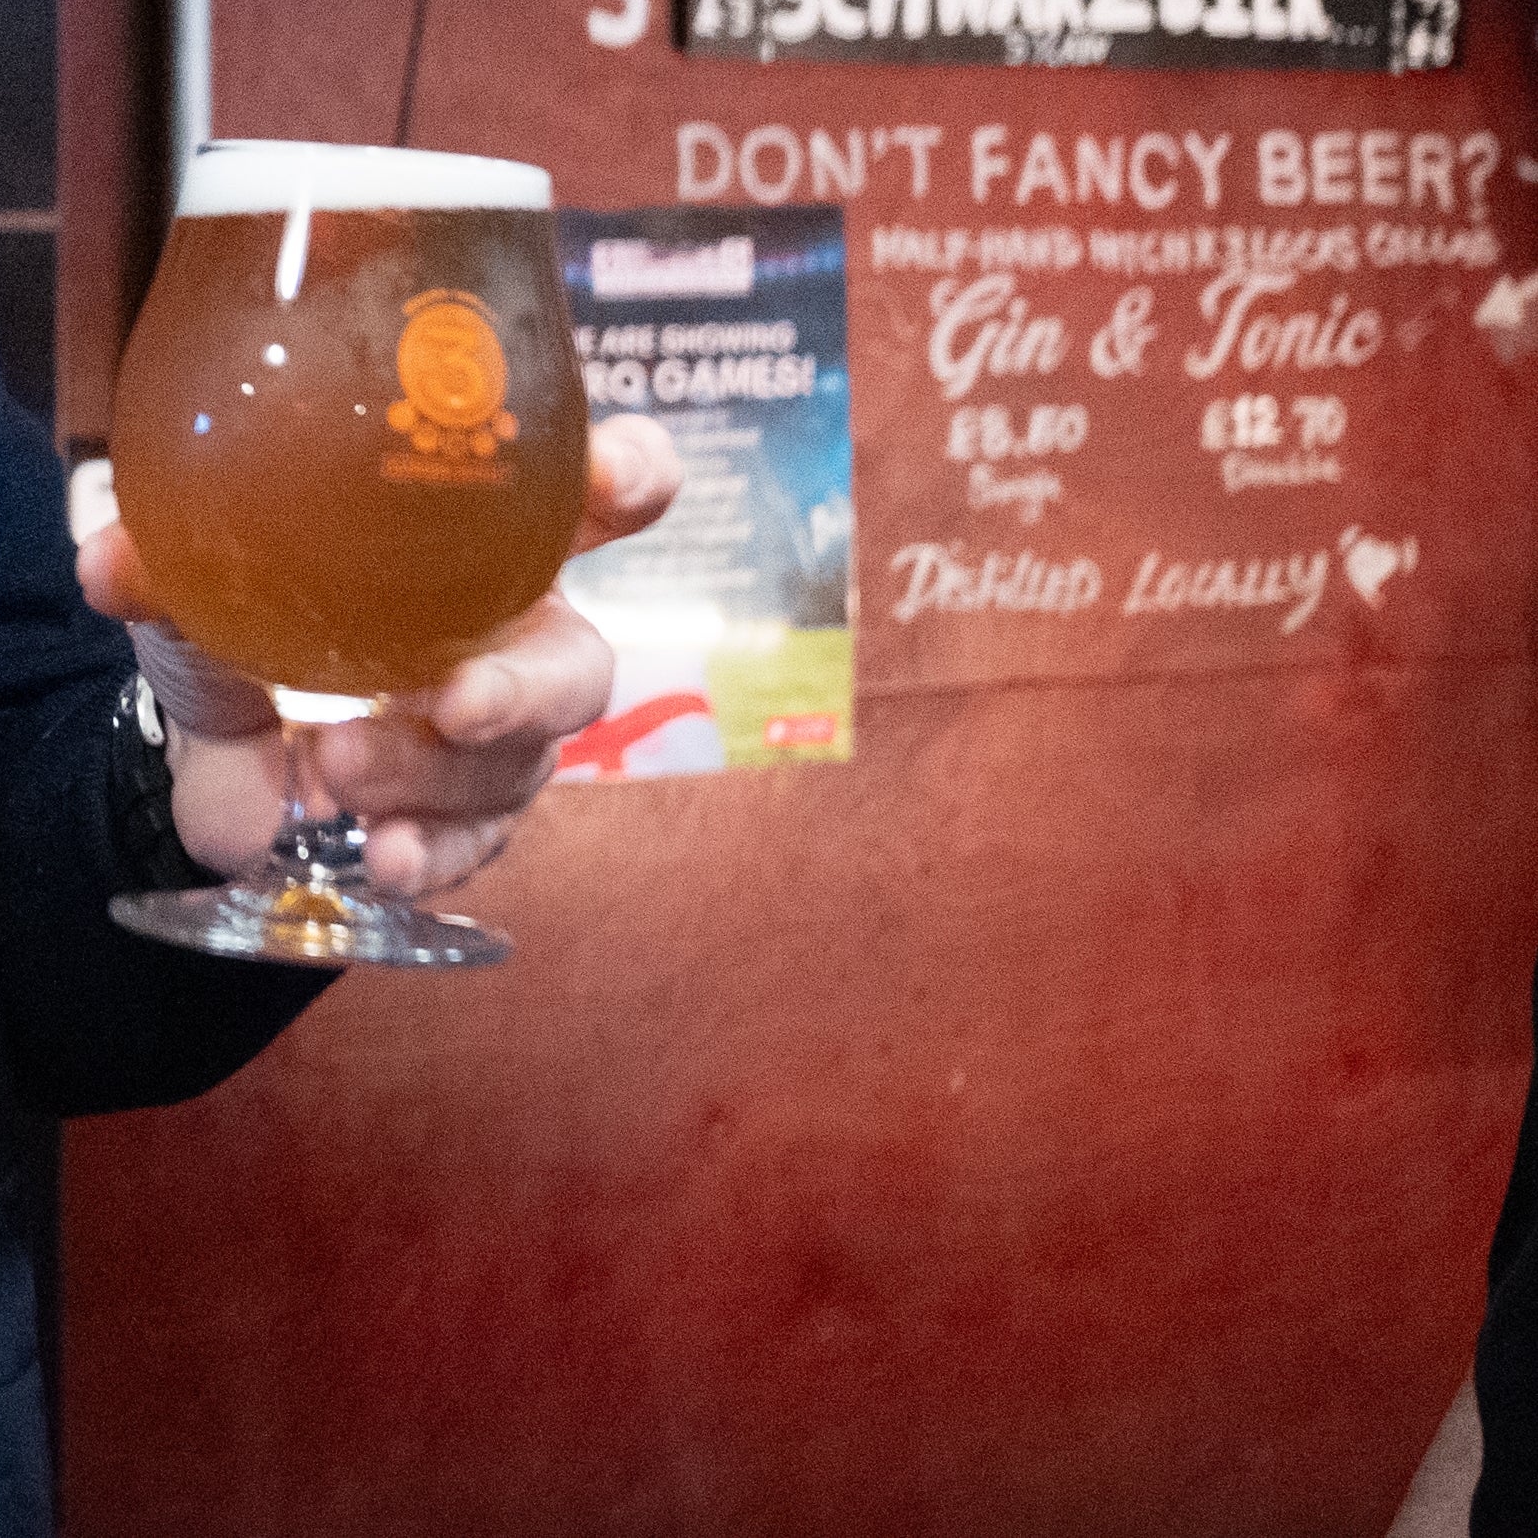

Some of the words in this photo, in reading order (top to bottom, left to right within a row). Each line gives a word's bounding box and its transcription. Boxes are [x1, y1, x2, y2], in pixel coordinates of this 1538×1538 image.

[675, 120, 943, 205] DON'T
[970, 121, 1233, 212] FANCY
[1257, 128, 1501, 224] BEER?
[660, 318, 798, 358] SHOWING
[927, 273, 1066, 401] Gin
[1089, 286, 1157, 380] &
[1184, 268, 1384, 380] Tonic
[652, 352, 817, 405] GAMES!
